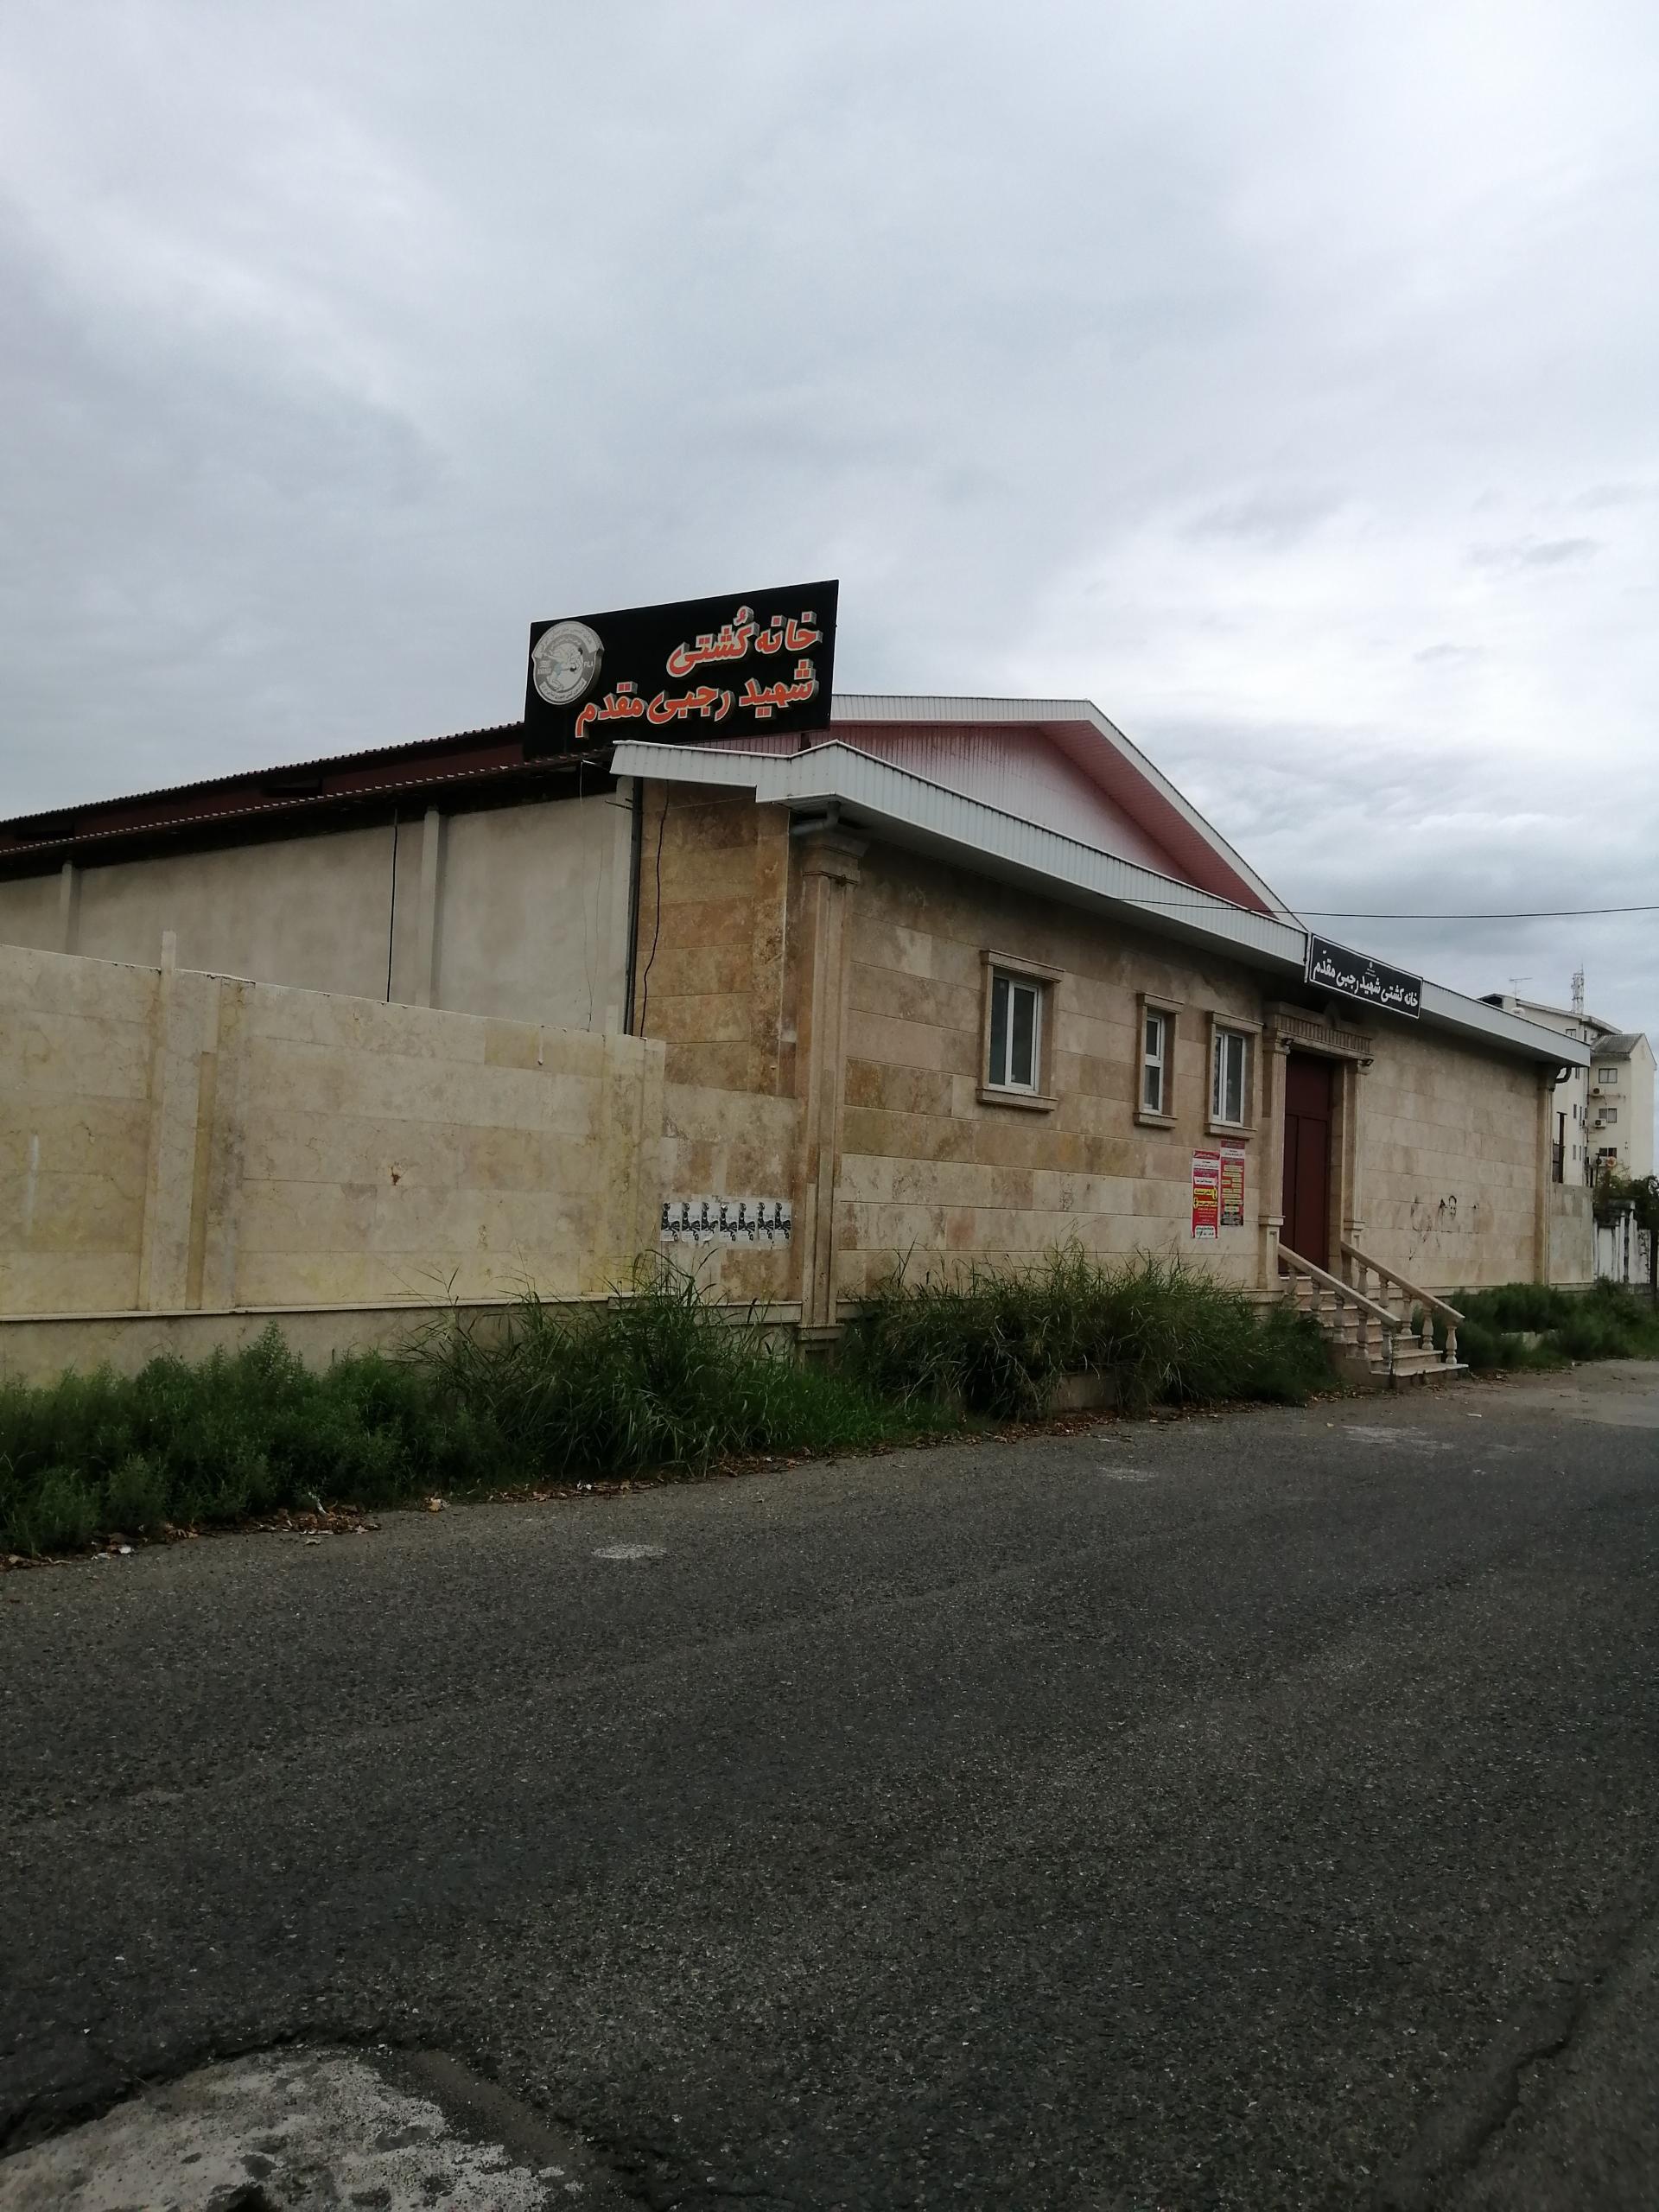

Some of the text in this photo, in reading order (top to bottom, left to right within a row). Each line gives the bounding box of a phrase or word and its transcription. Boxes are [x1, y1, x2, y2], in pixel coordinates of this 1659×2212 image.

[754, 611, 823, 655] خانه
[575, 658, 819, 739] شهید رجبی مقدم
[1336, 973, 1359, 995] رجبی
[1359, 976, 1381, 995] شهید
[1381, 985, 1405, 1002] کشتی
[1404, 991, 1418, 1007] خانه
